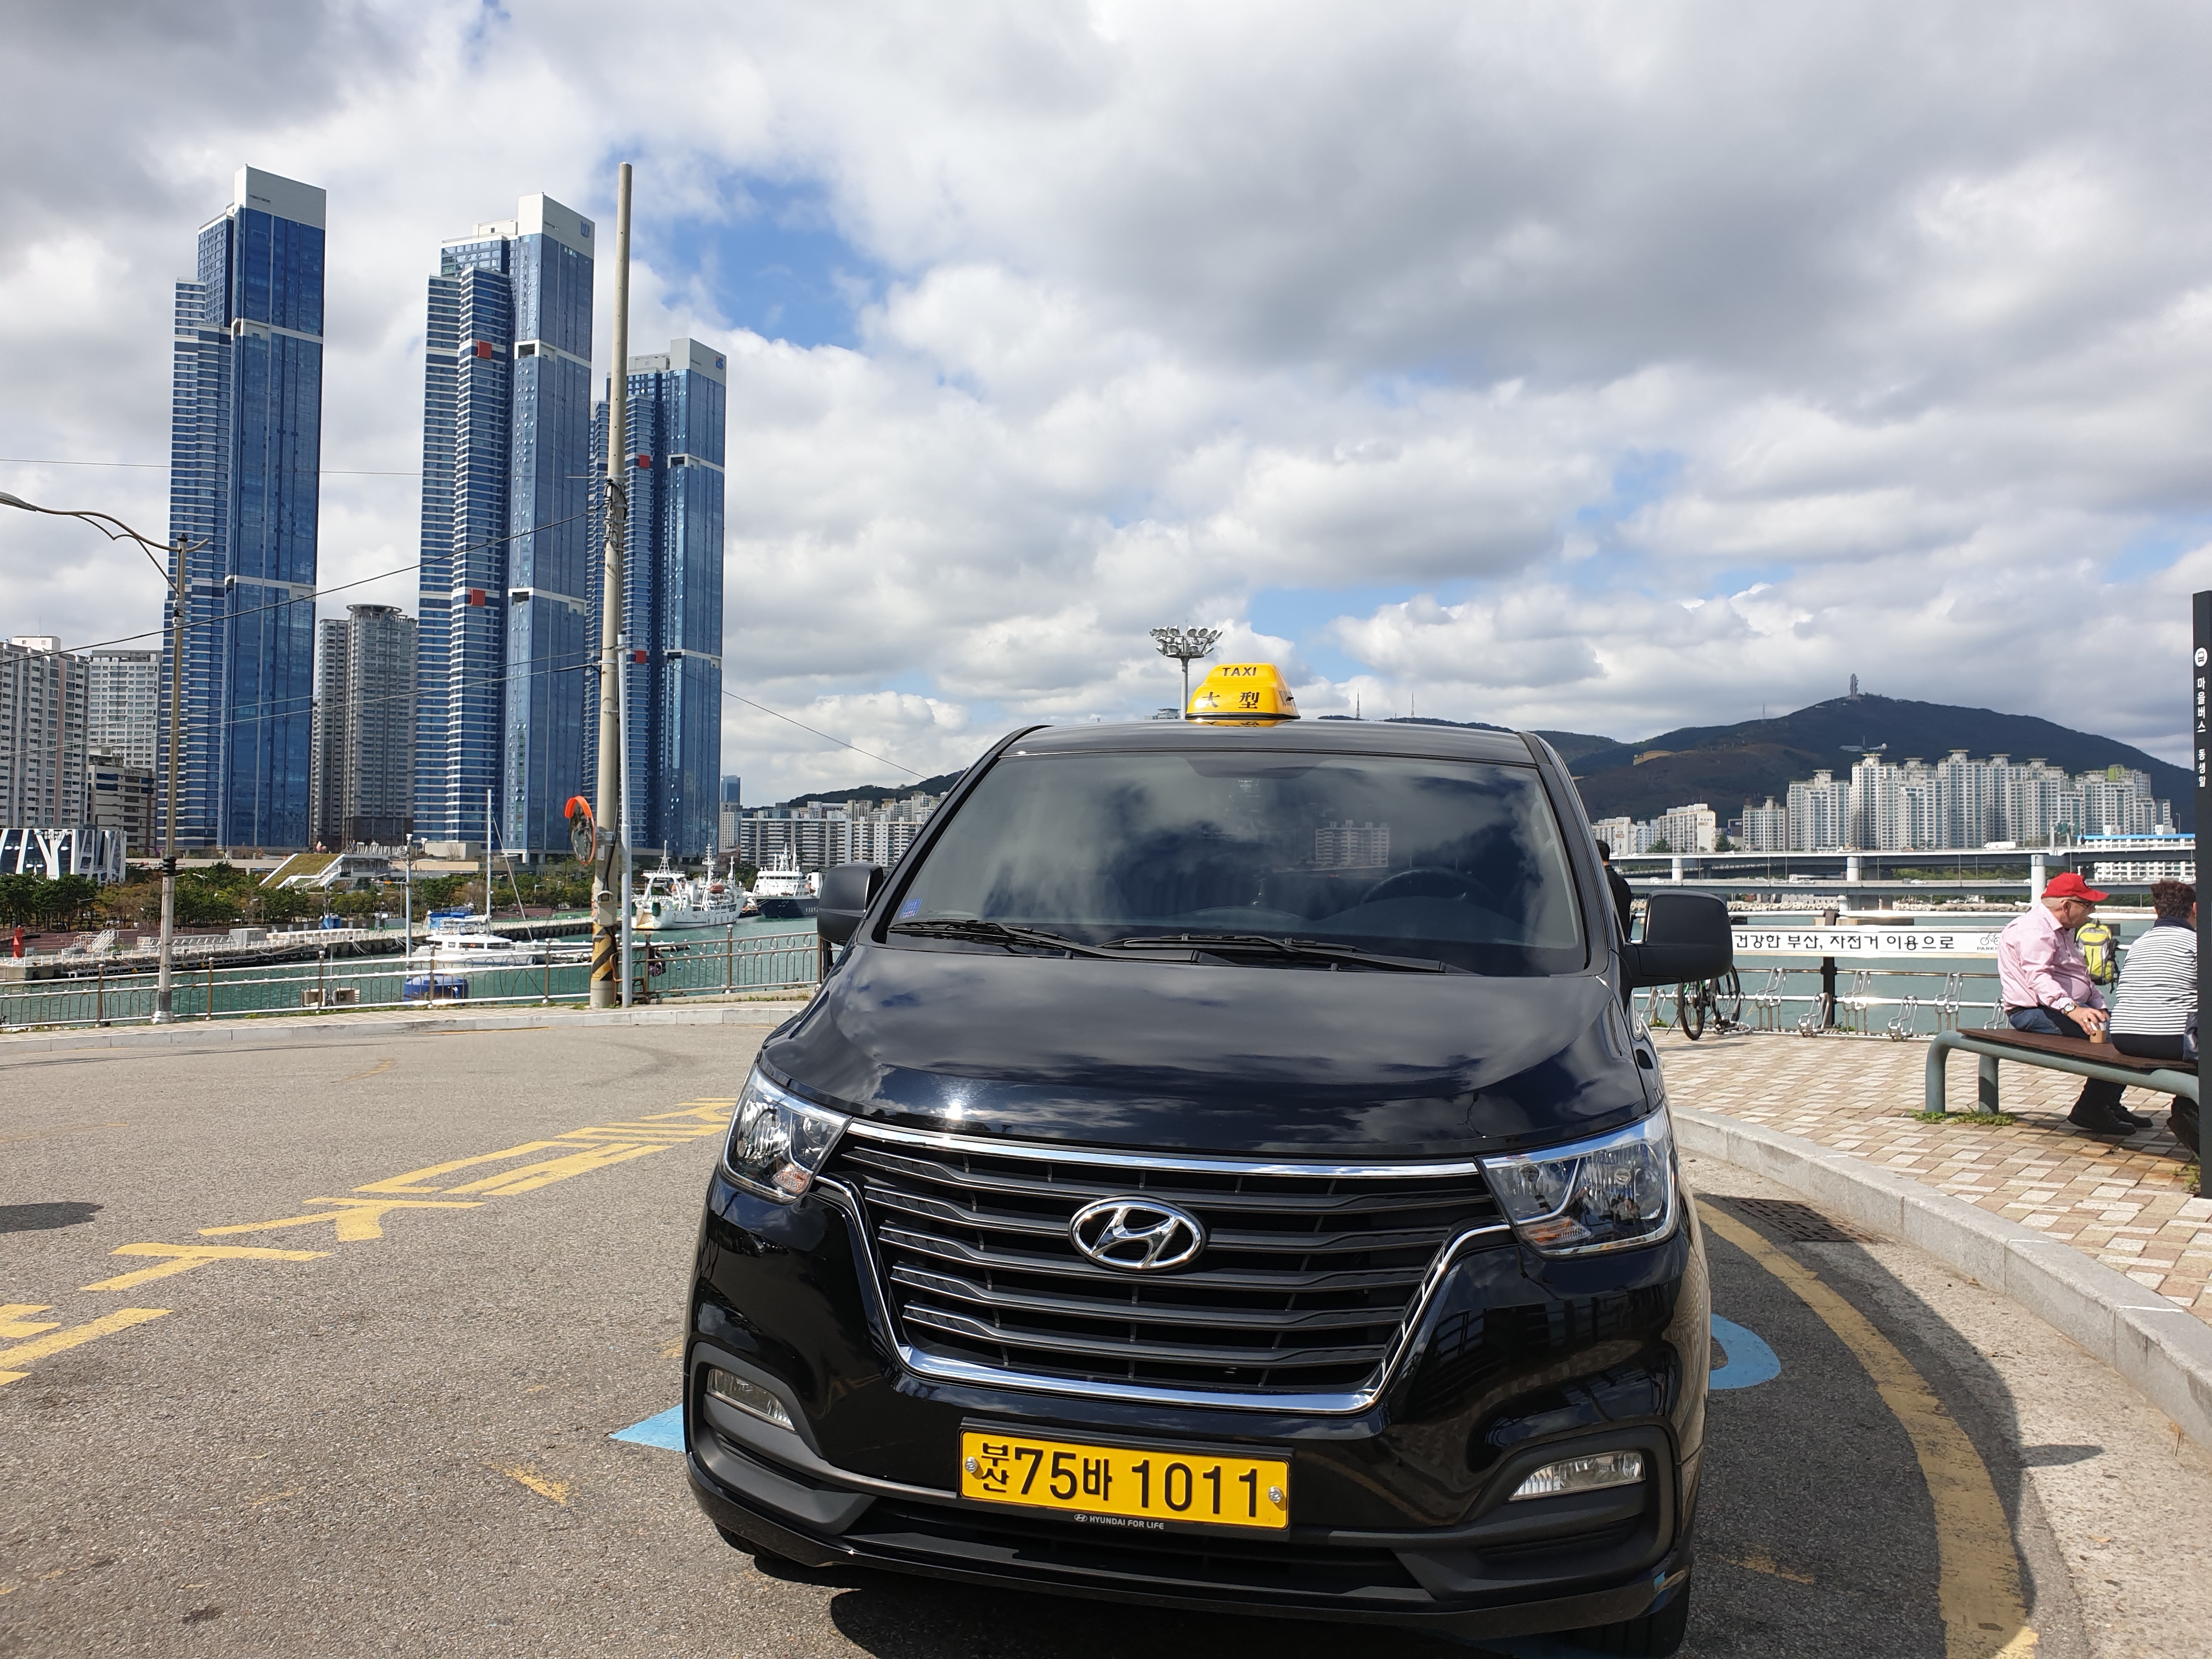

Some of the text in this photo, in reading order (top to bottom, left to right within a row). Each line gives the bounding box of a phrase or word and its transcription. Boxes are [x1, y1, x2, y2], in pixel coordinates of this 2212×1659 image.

[1222, 667, 1257, 676] TAXI
[2197, 676, 2207, 788] 마을버스 동생말
[1734, 935, 1955, 951] 건강한 부산, 자전거 이용으로
[980, 1442, 1257, 1517] 부산 75바 1011
[1090, 1515, 1165, 1530] HYUNDAI FOR LIFE
